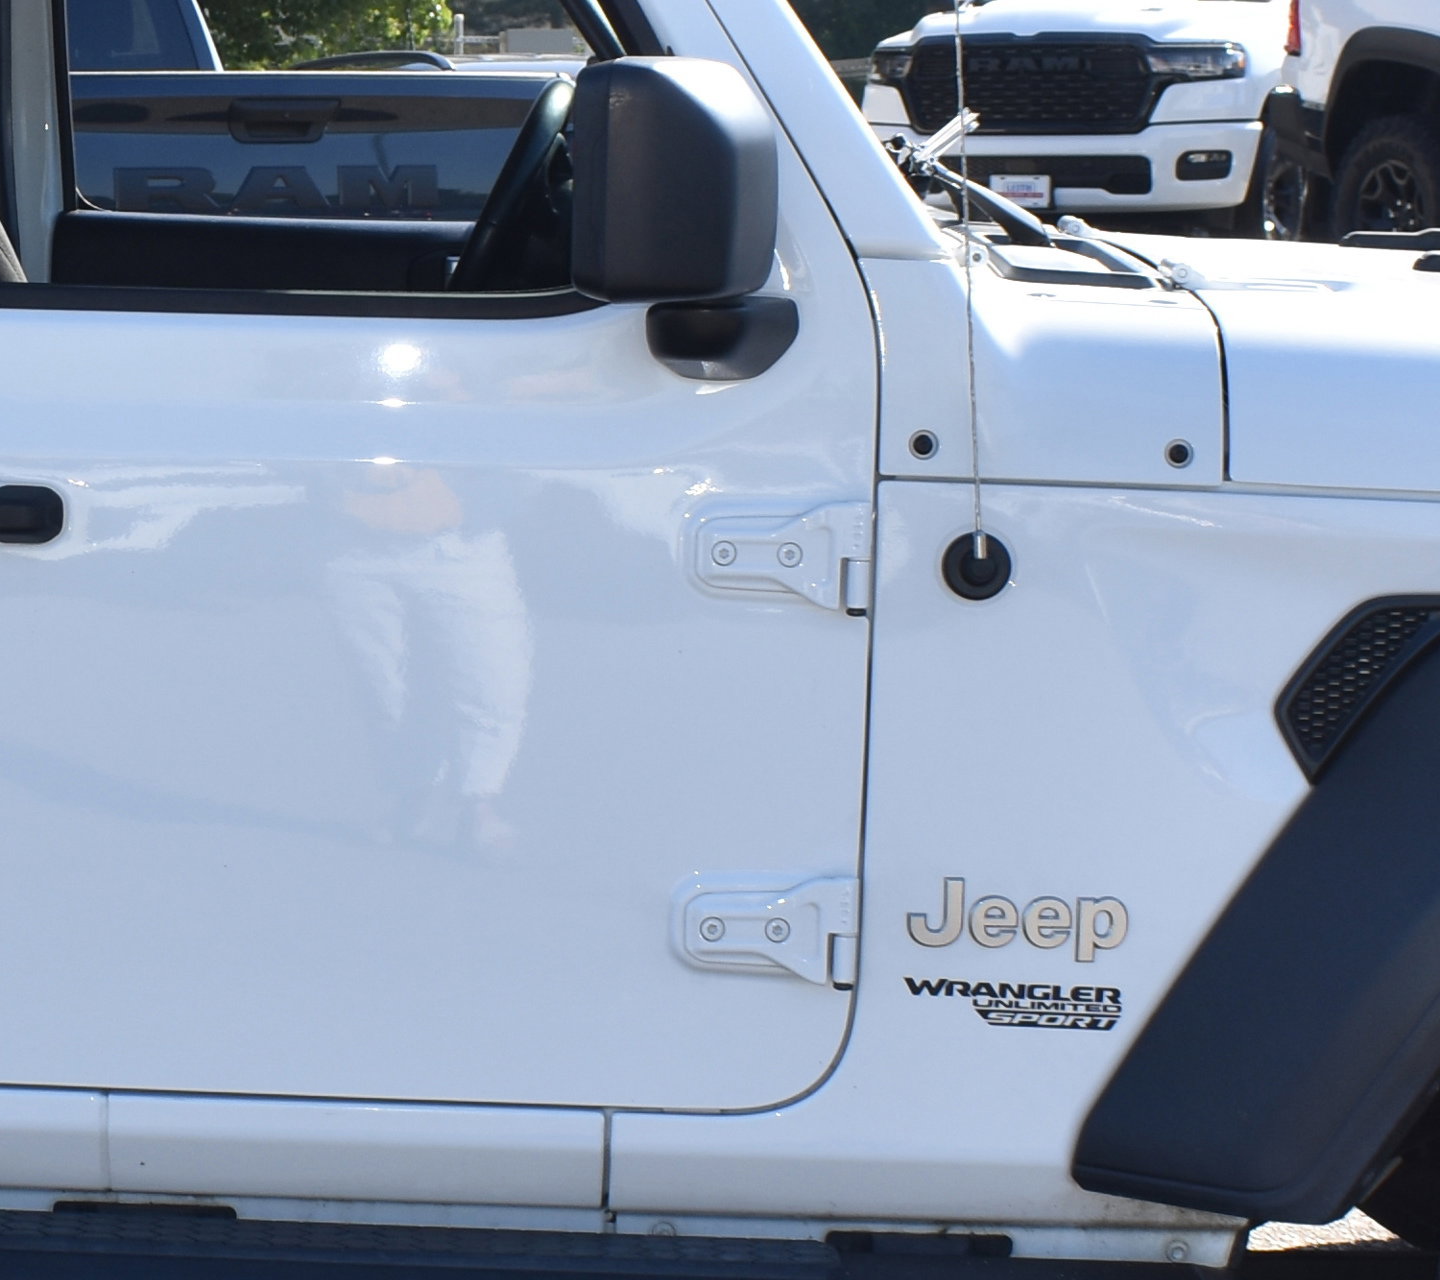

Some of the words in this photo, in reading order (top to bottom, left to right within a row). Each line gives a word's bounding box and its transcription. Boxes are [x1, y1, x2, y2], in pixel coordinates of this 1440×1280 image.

[970, 56, 1082, 72] RAM
[113, 165, 439, 210] RAM
[906, 877, 1129, 963] Jeep
[903, 976, 1122, 1005] WRANGLER
[972, 998, 1123, 1014] UNLIMITED
[985, 1011, 1114, 1030] SPORT
